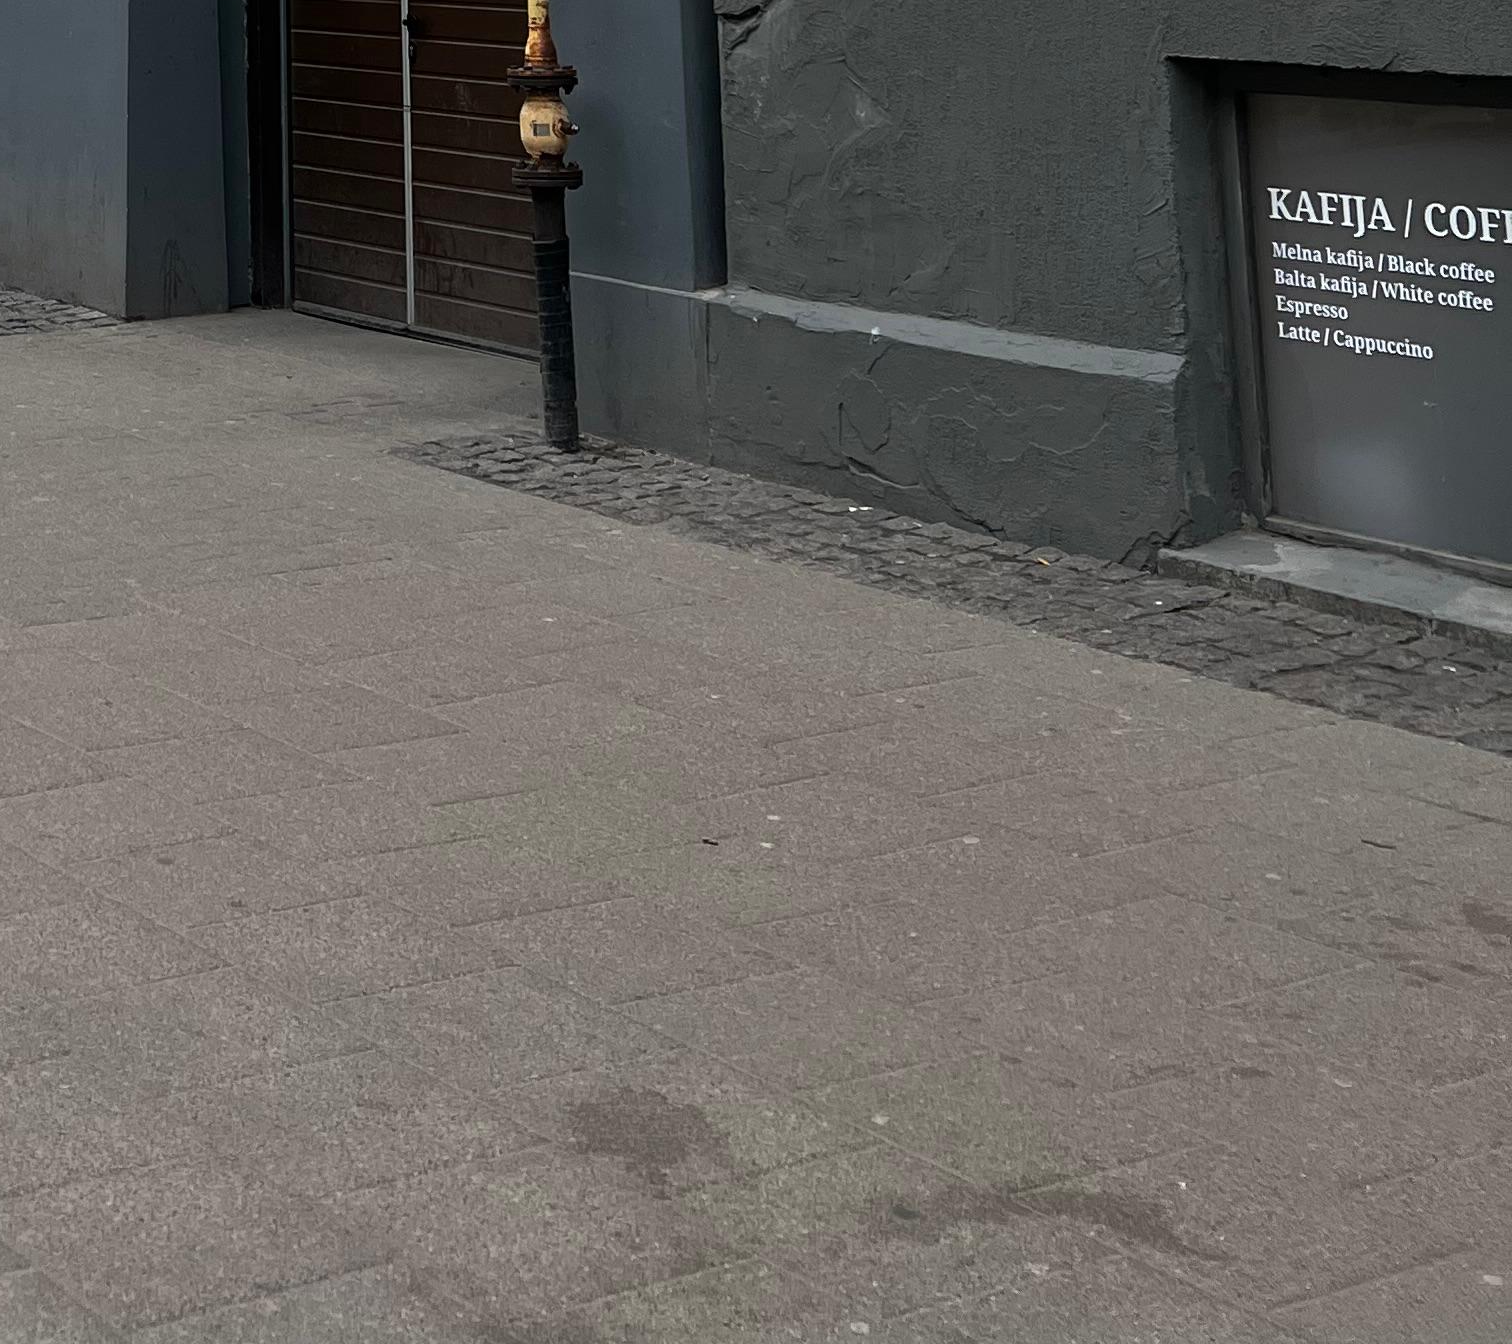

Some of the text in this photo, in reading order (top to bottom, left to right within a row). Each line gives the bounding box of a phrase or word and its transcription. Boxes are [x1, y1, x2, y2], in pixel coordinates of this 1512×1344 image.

[1267, 187, 1396, 237] KAFIJA
[1404, 199, 1413, 238] /
[1272, 242, 1495, 284] Melna kafija / Black coffee
[1274, 269, 1316, 289] Balta
[1320, 273, 1368, 298] kafija
[1380, 281, 1434, 304] White
[1438, 290, 1494, 312] coffee
[1275, 295, 1349, 320] Espresso
[1278, 322, 1434, 359] Latte / Cappuccino
